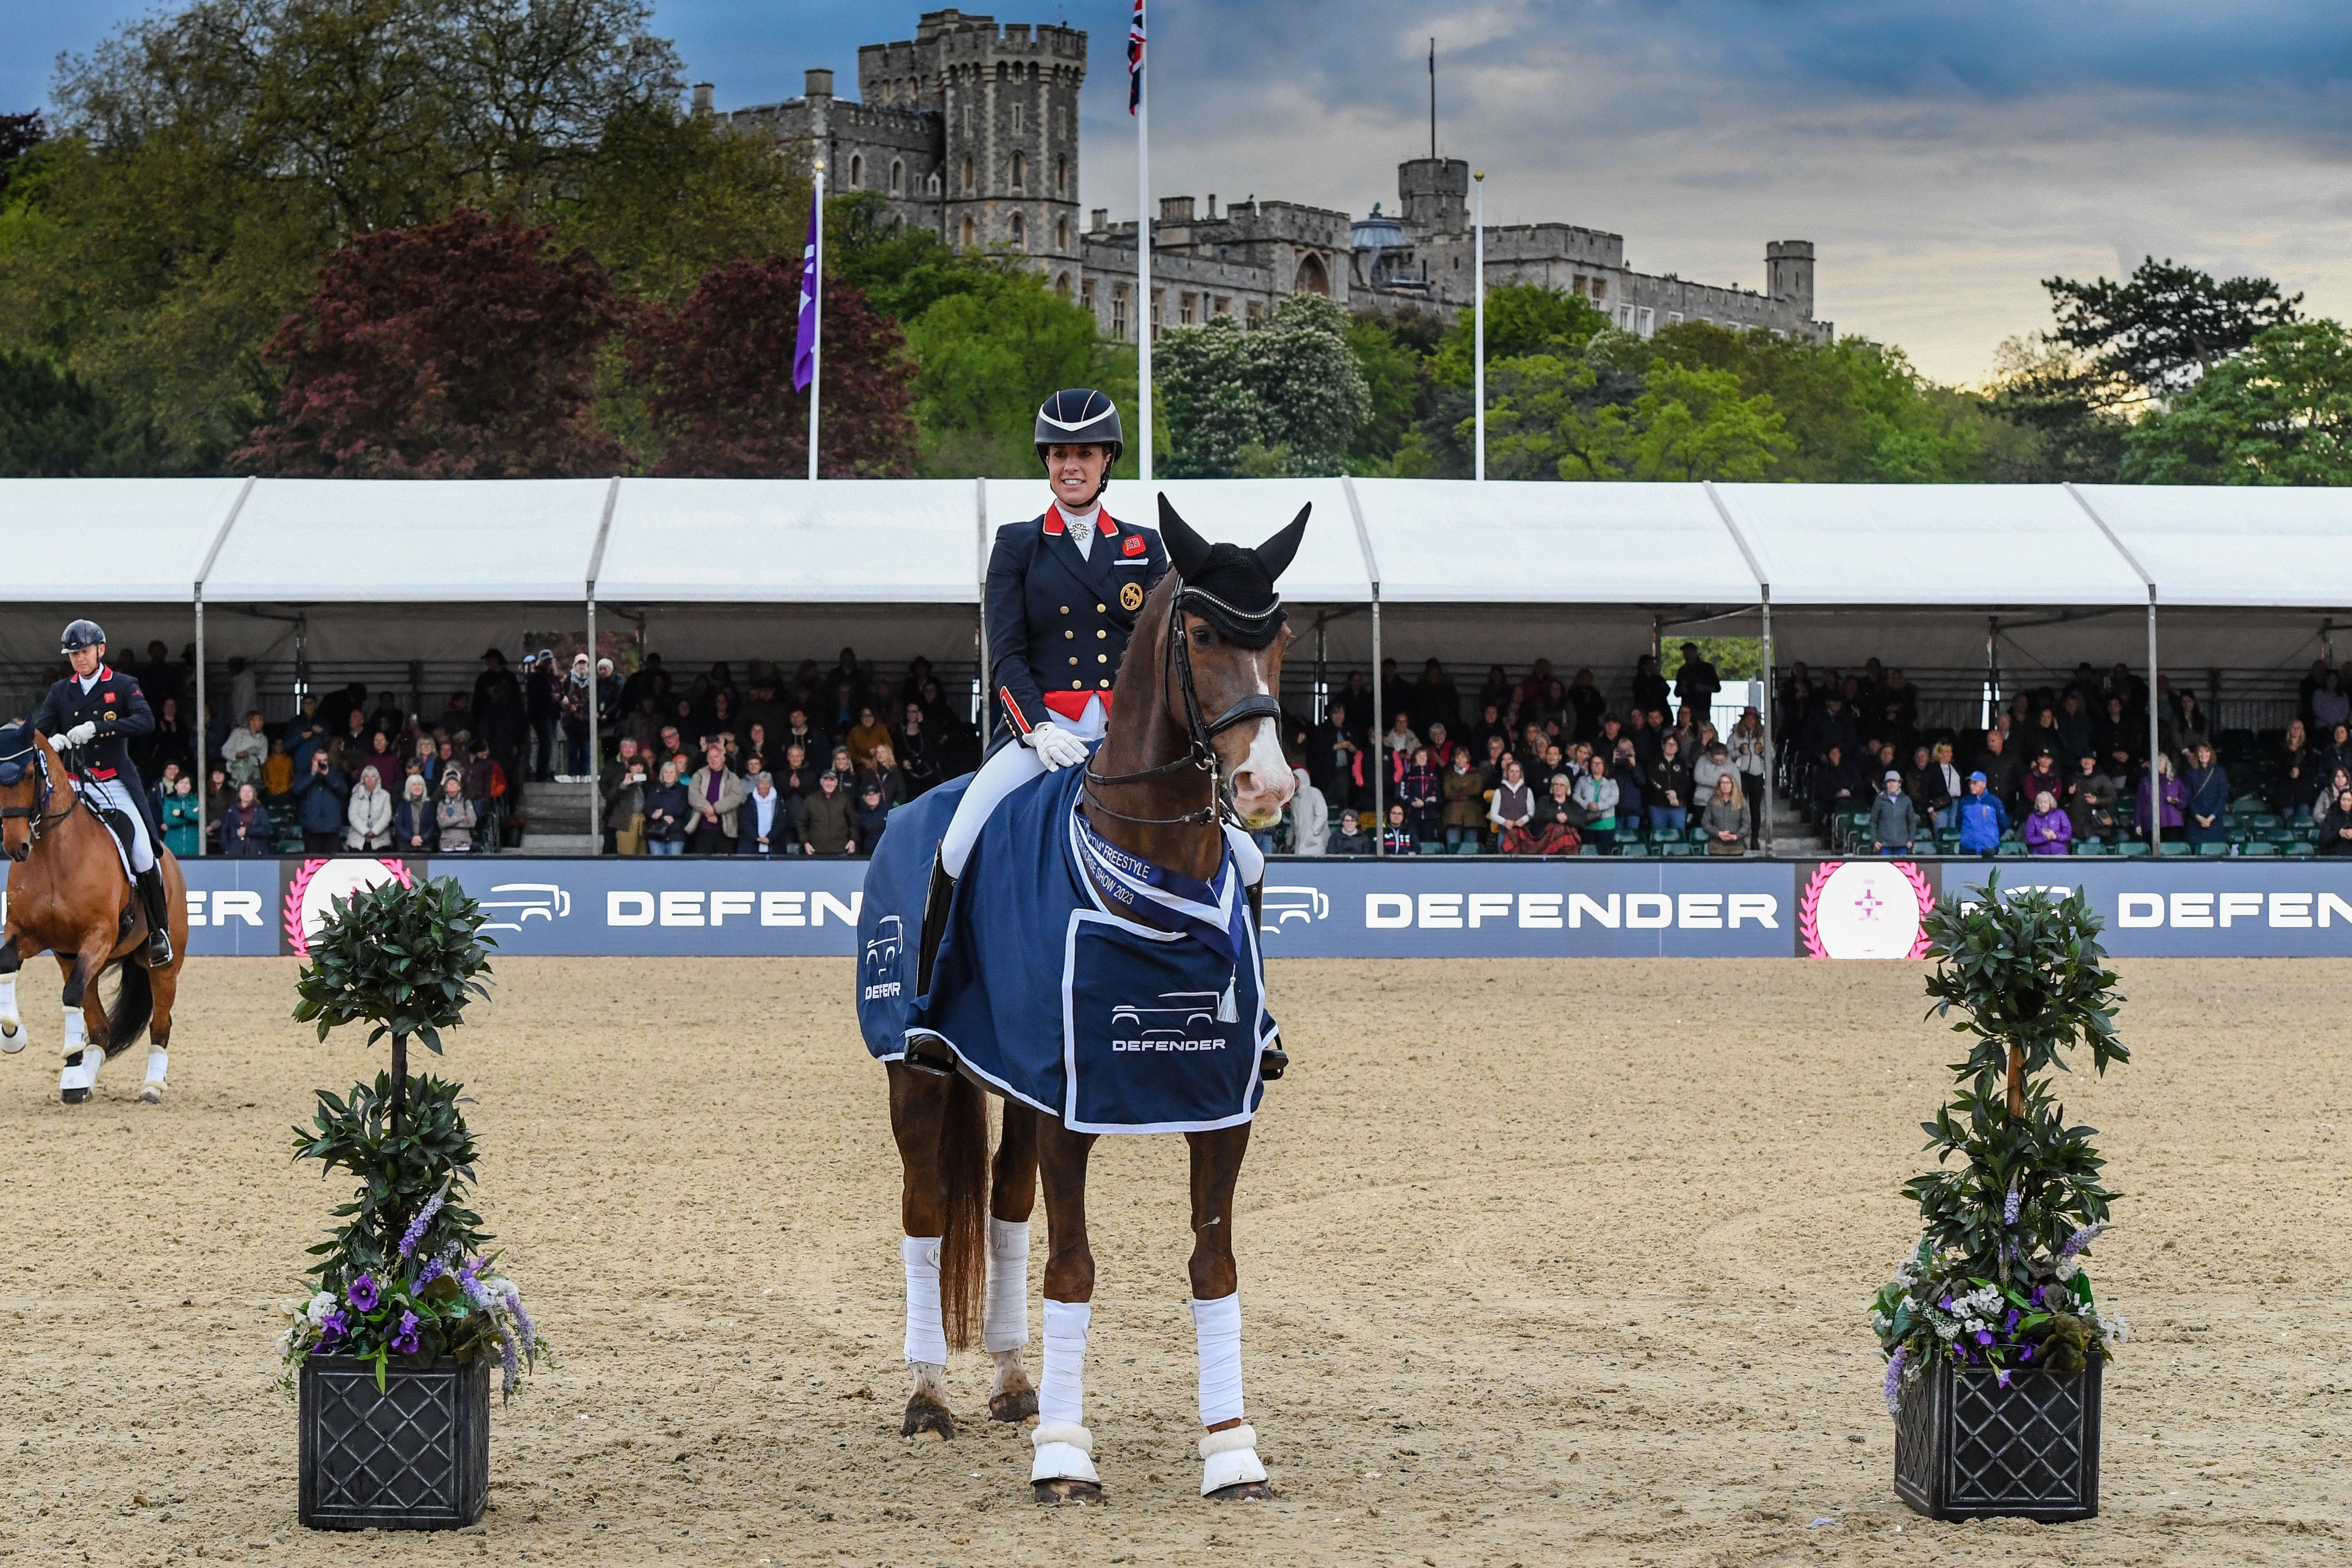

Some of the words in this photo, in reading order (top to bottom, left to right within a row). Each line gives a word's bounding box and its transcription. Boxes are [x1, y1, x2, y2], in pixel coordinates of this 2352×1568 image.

[1082, 845, 1097, 874] HORSE
[1095, 867, 1117, 892] SHOW
[1113, 885, 1135, 905] 2023
[1103, 844, 1150, 879] FREESTYLE
[607, 891, 863, 926] DEFEN
[1366, 893, 1779, 929] DEFENDER
[2118, 892, 2352, 928] DEFEN
[1112, 1038, 1226, 1052] DEFENDER
